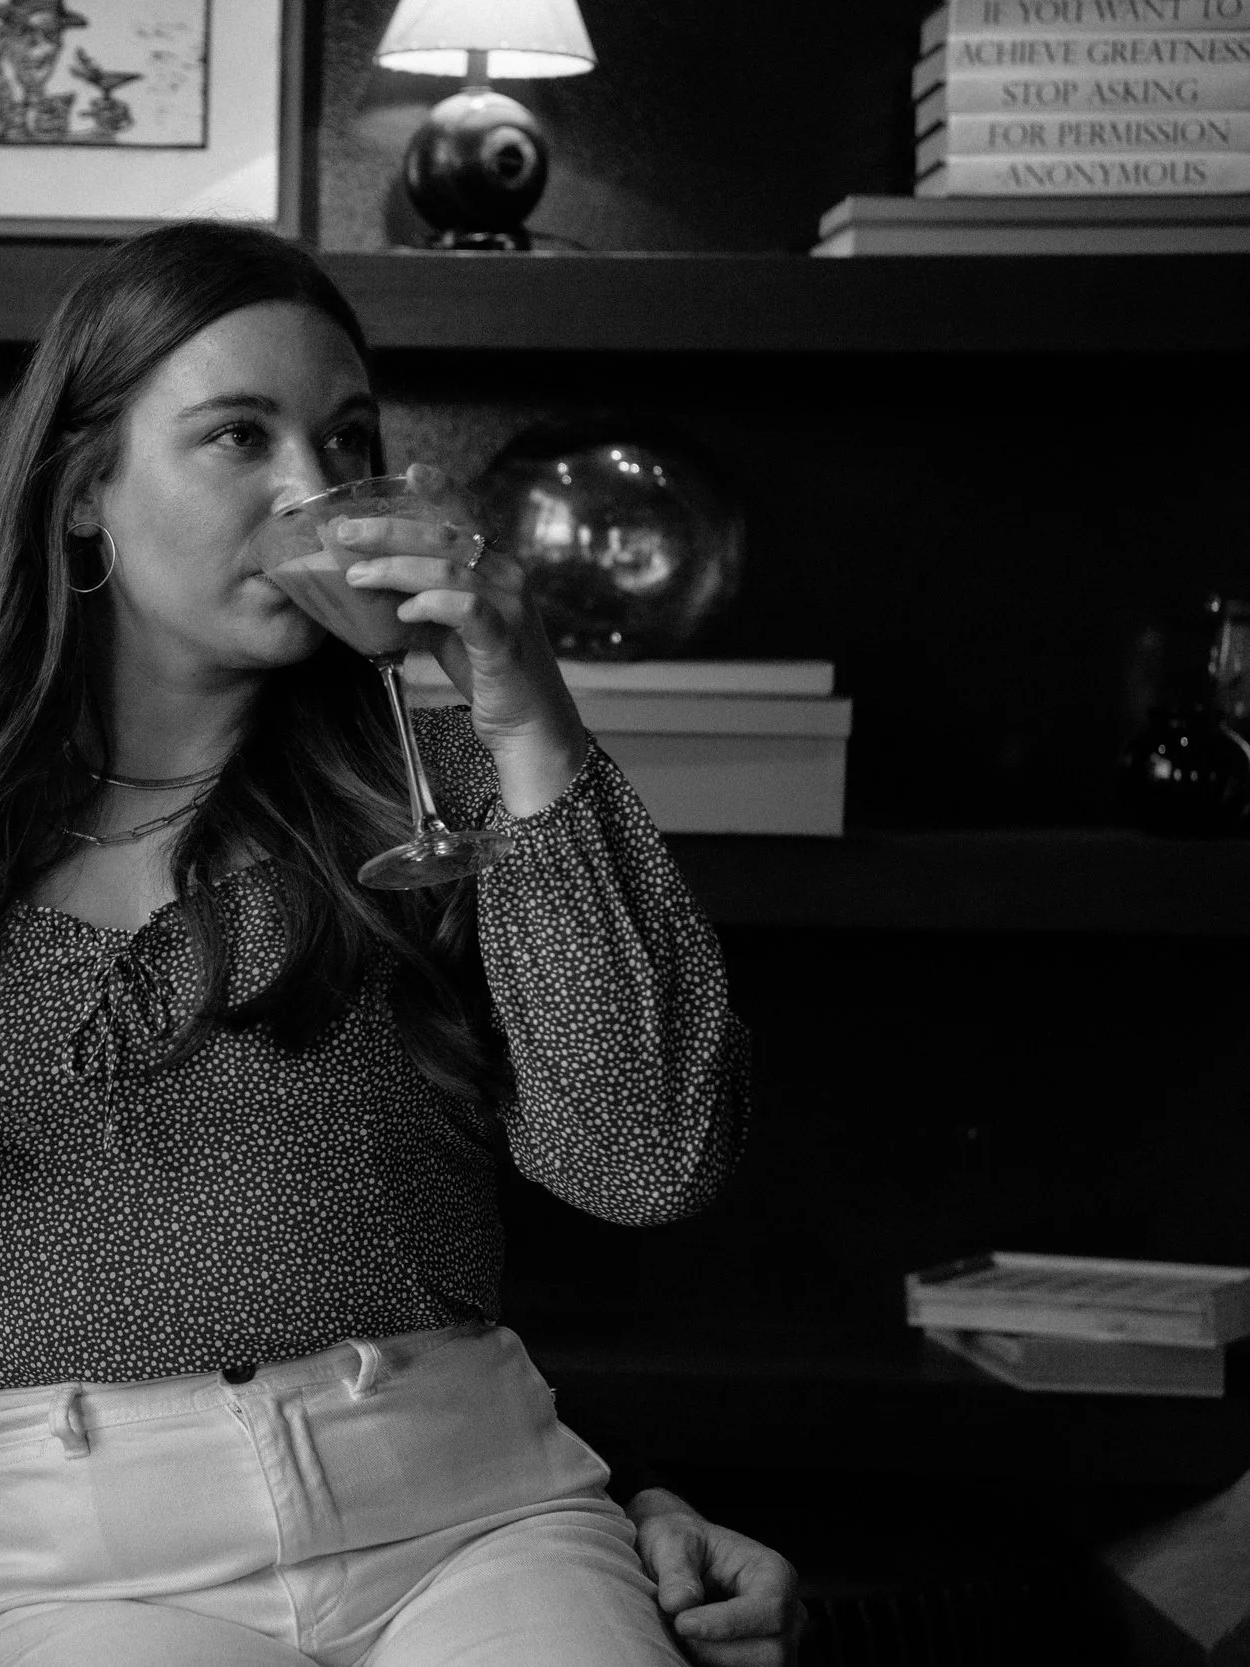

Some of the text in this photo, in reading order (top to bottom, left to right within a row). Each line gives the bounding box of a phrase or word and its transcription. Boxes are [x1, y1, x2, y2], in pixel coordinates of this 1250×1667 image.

[981, 0, 1003, 25] IF
[1015, 0, 1084, 25] YOU
[1087, 0, 1184, 23] WANT
[957, 38, 1250, 66] ACHIEVE GREATNESS
[1001, 77, 1199, 107] STOP ASKING
[987, 117, 1231, 148] FOR PERMISSION
[1003, 159, 1209, 188] ANONYMOUS
